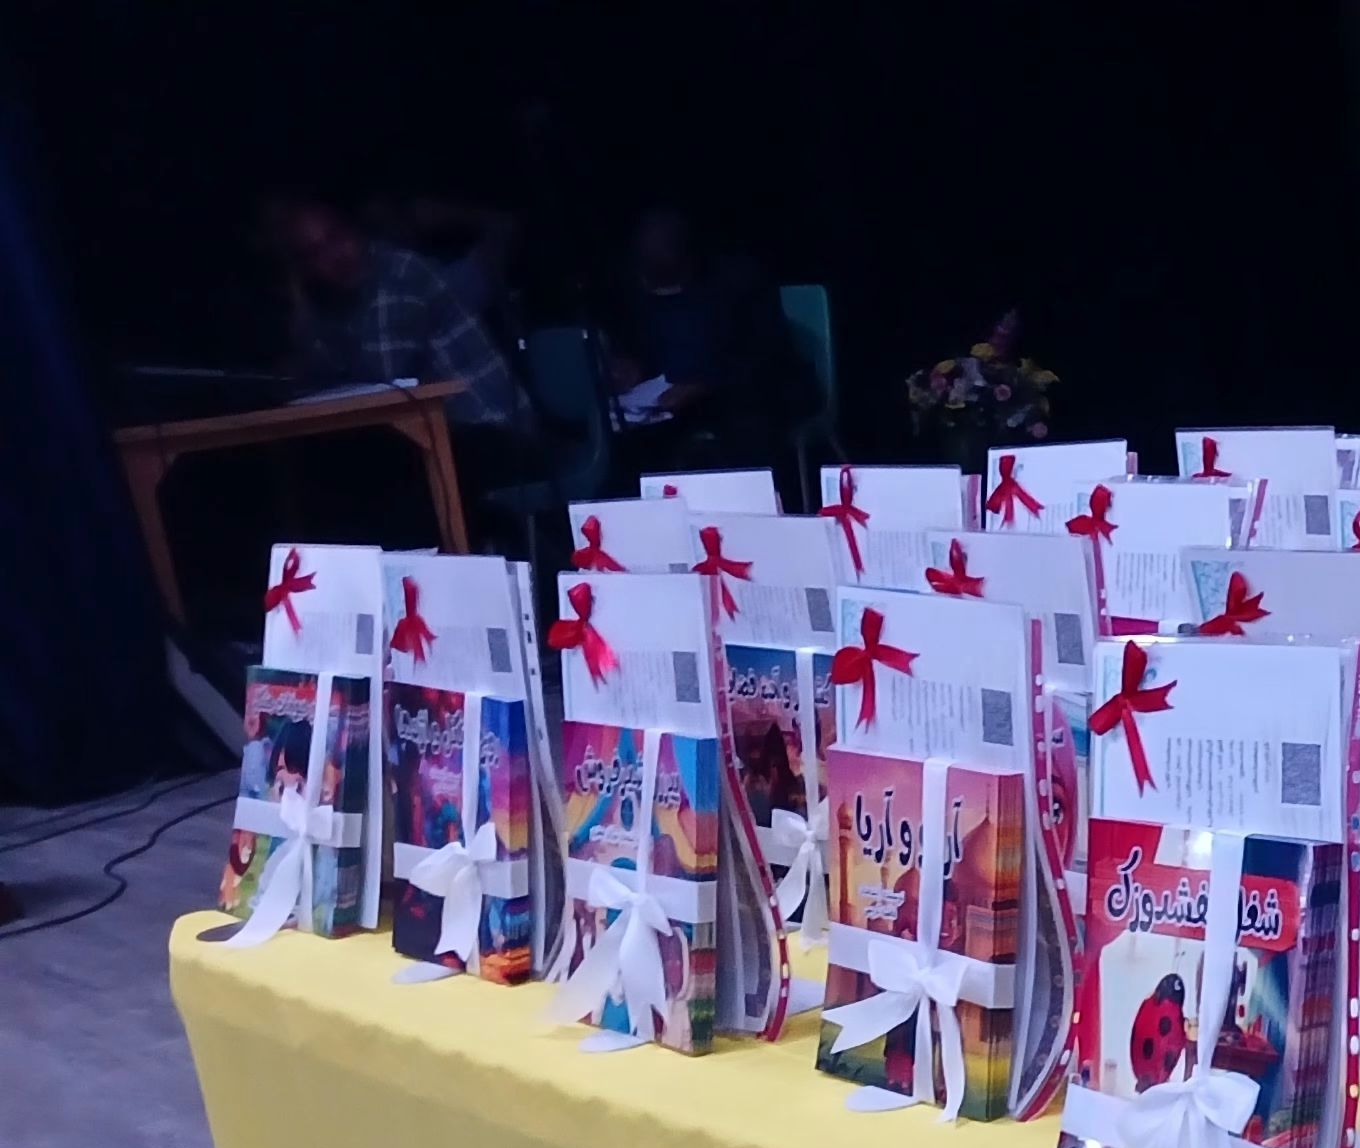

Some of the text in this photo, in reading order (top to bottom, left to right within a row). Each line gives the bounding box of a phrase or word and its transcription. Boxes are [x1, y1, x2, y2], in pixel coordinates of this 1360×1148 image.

[855, 789, 894, 864] آریا
[898, 819, 913, 867] و
[1107, 848, 1210, 933] فشدوزک
